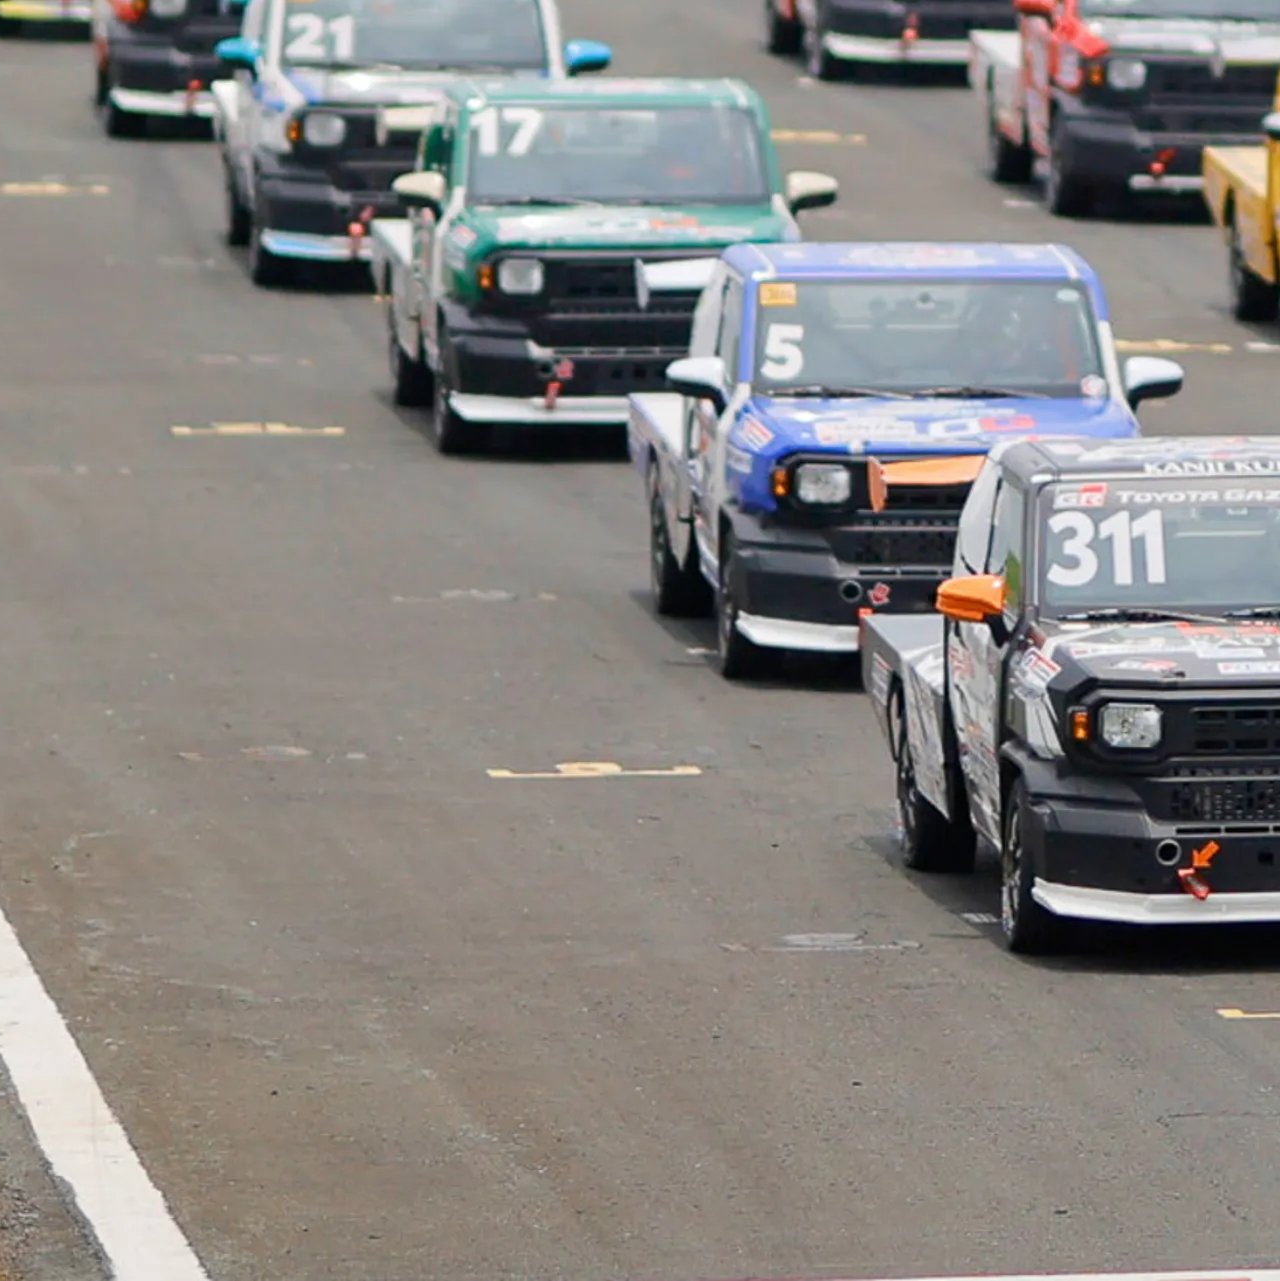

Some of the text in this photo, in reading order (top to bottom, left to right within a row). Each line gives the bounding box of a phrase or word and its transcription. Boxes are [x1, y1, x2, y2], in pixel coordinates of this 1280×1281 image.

[284, 14, 355, 60] 21
[470, 106, 543, 157] 17
[760, 323, 805, 381] 5
[1143, 459, 1226, 476] KANJI
[1116, 489, 1219, 505] TOYOTA
[1046, 509, 1167, 588] 311
